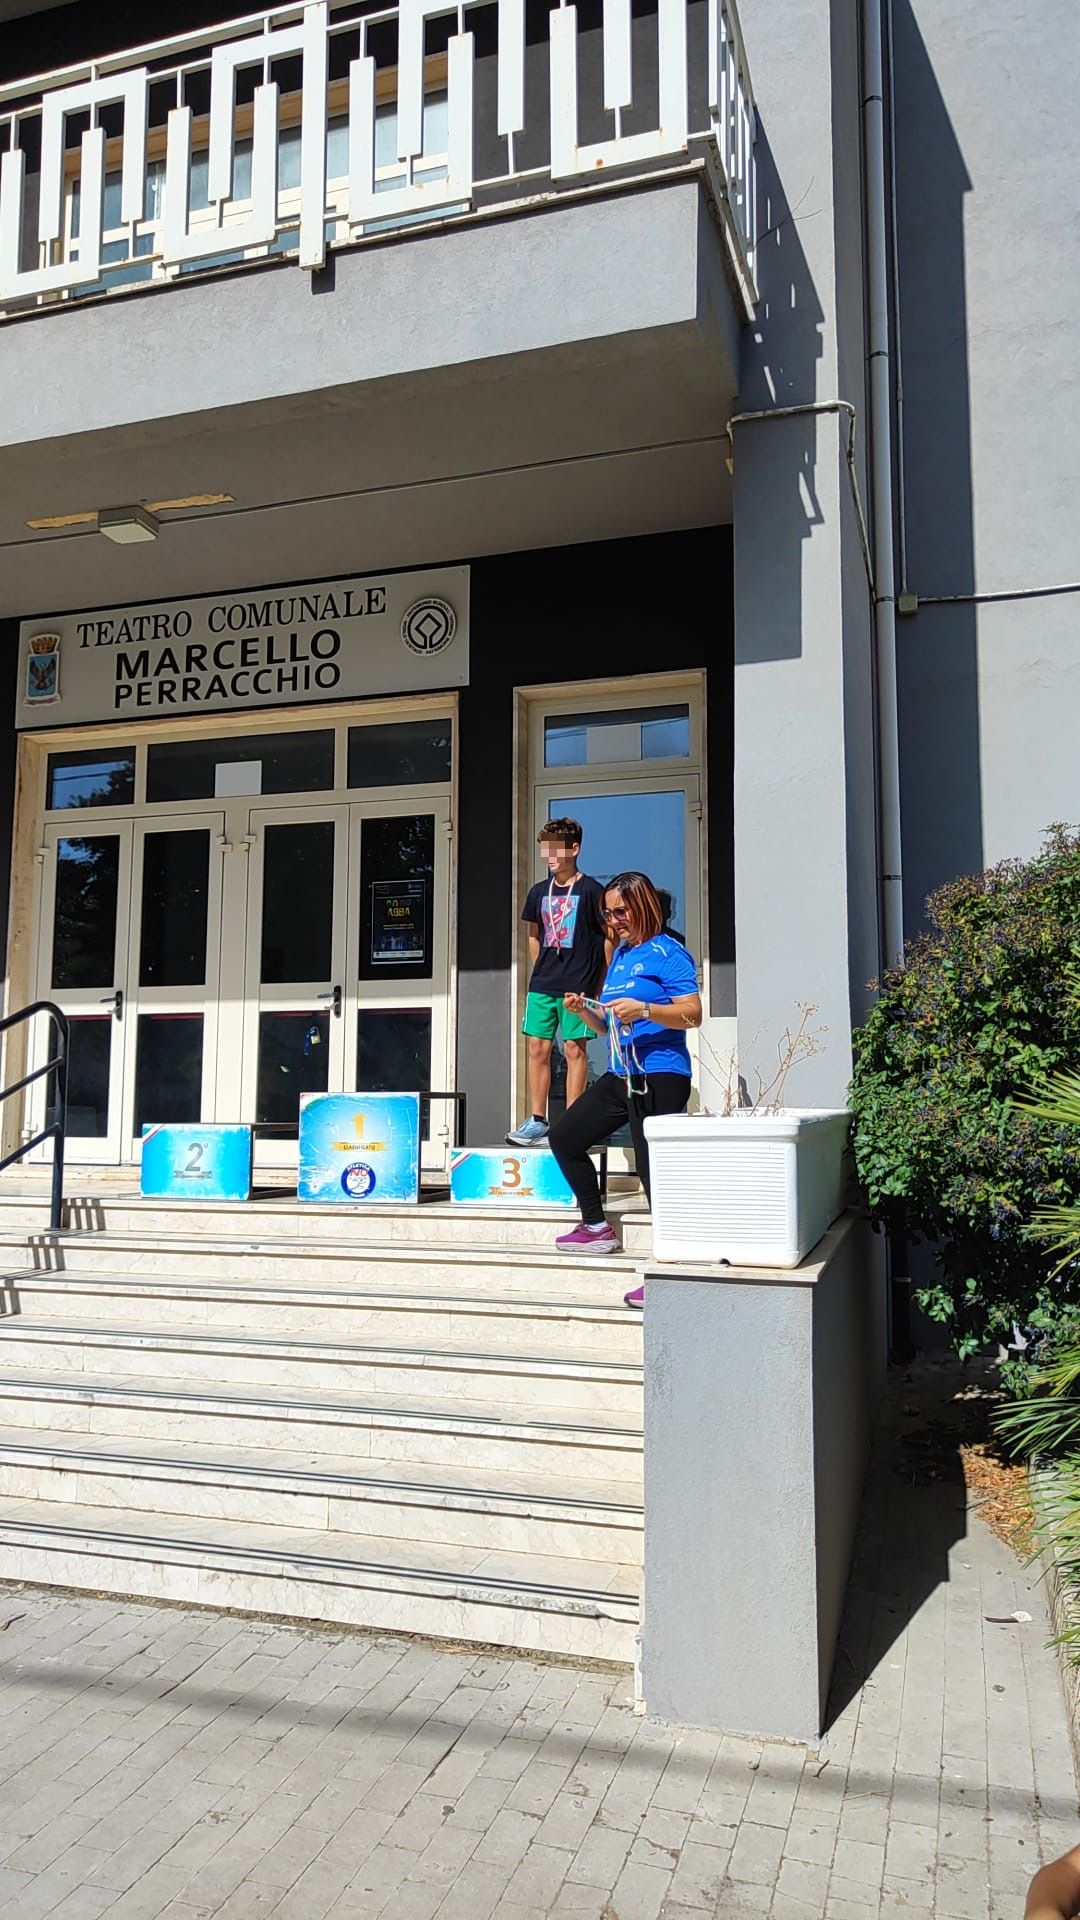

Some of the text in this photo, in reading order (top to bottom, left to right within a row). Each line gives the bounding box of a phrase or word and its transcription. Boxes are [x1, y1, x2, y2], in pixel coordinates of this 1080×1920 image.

[77, 611, 192, 648] TEATRO
[207, 586, 387, 633] COMUNALE
[115, 628, 341, 681] MARCELLO
[114, 662, 341, 709] PERRACCHIO
[387, 907, 410, 917] ABBA
